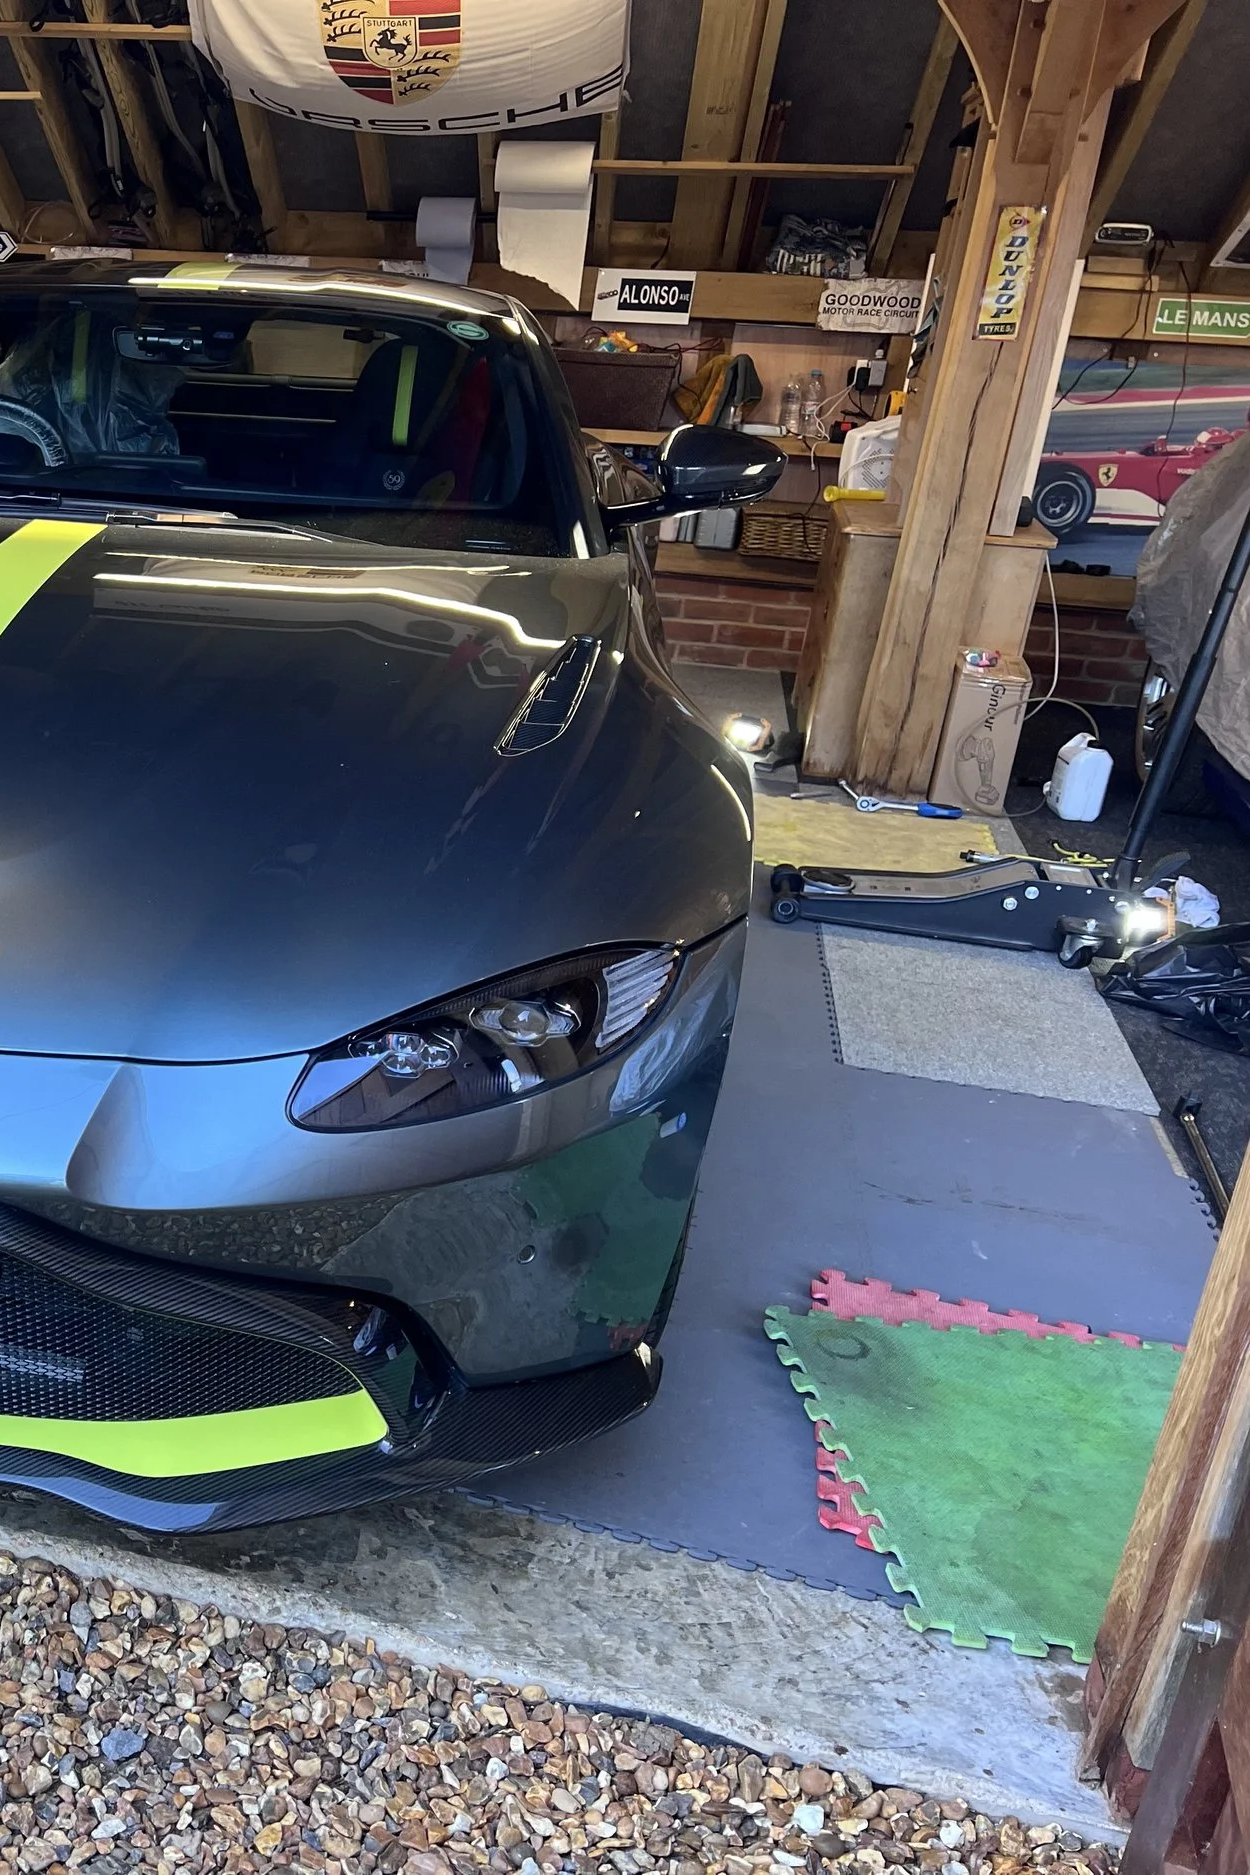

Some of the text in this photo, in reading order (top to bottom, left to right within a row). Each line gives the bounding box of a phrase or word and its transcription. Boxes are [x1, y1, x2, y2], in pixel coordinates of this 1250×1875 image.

[367, 19, 412, 28] STUTTGART
[248, 62, 624, 132] ORSCHE
[990, 236, 1029, 318] DUNLOP
[620, 284, 679, 305] ALONSO
[679, 293, 690, 301] AVE
[825, 293, 921, 309] GOODWOOD
[822, 307, 920, 318] MOTOR RACE CIRCUIT
[1162, 309, 1250, 328] LE MANS
[983, 324, 1011, 333] TYRES
[388, 474, 401, 484] 59
